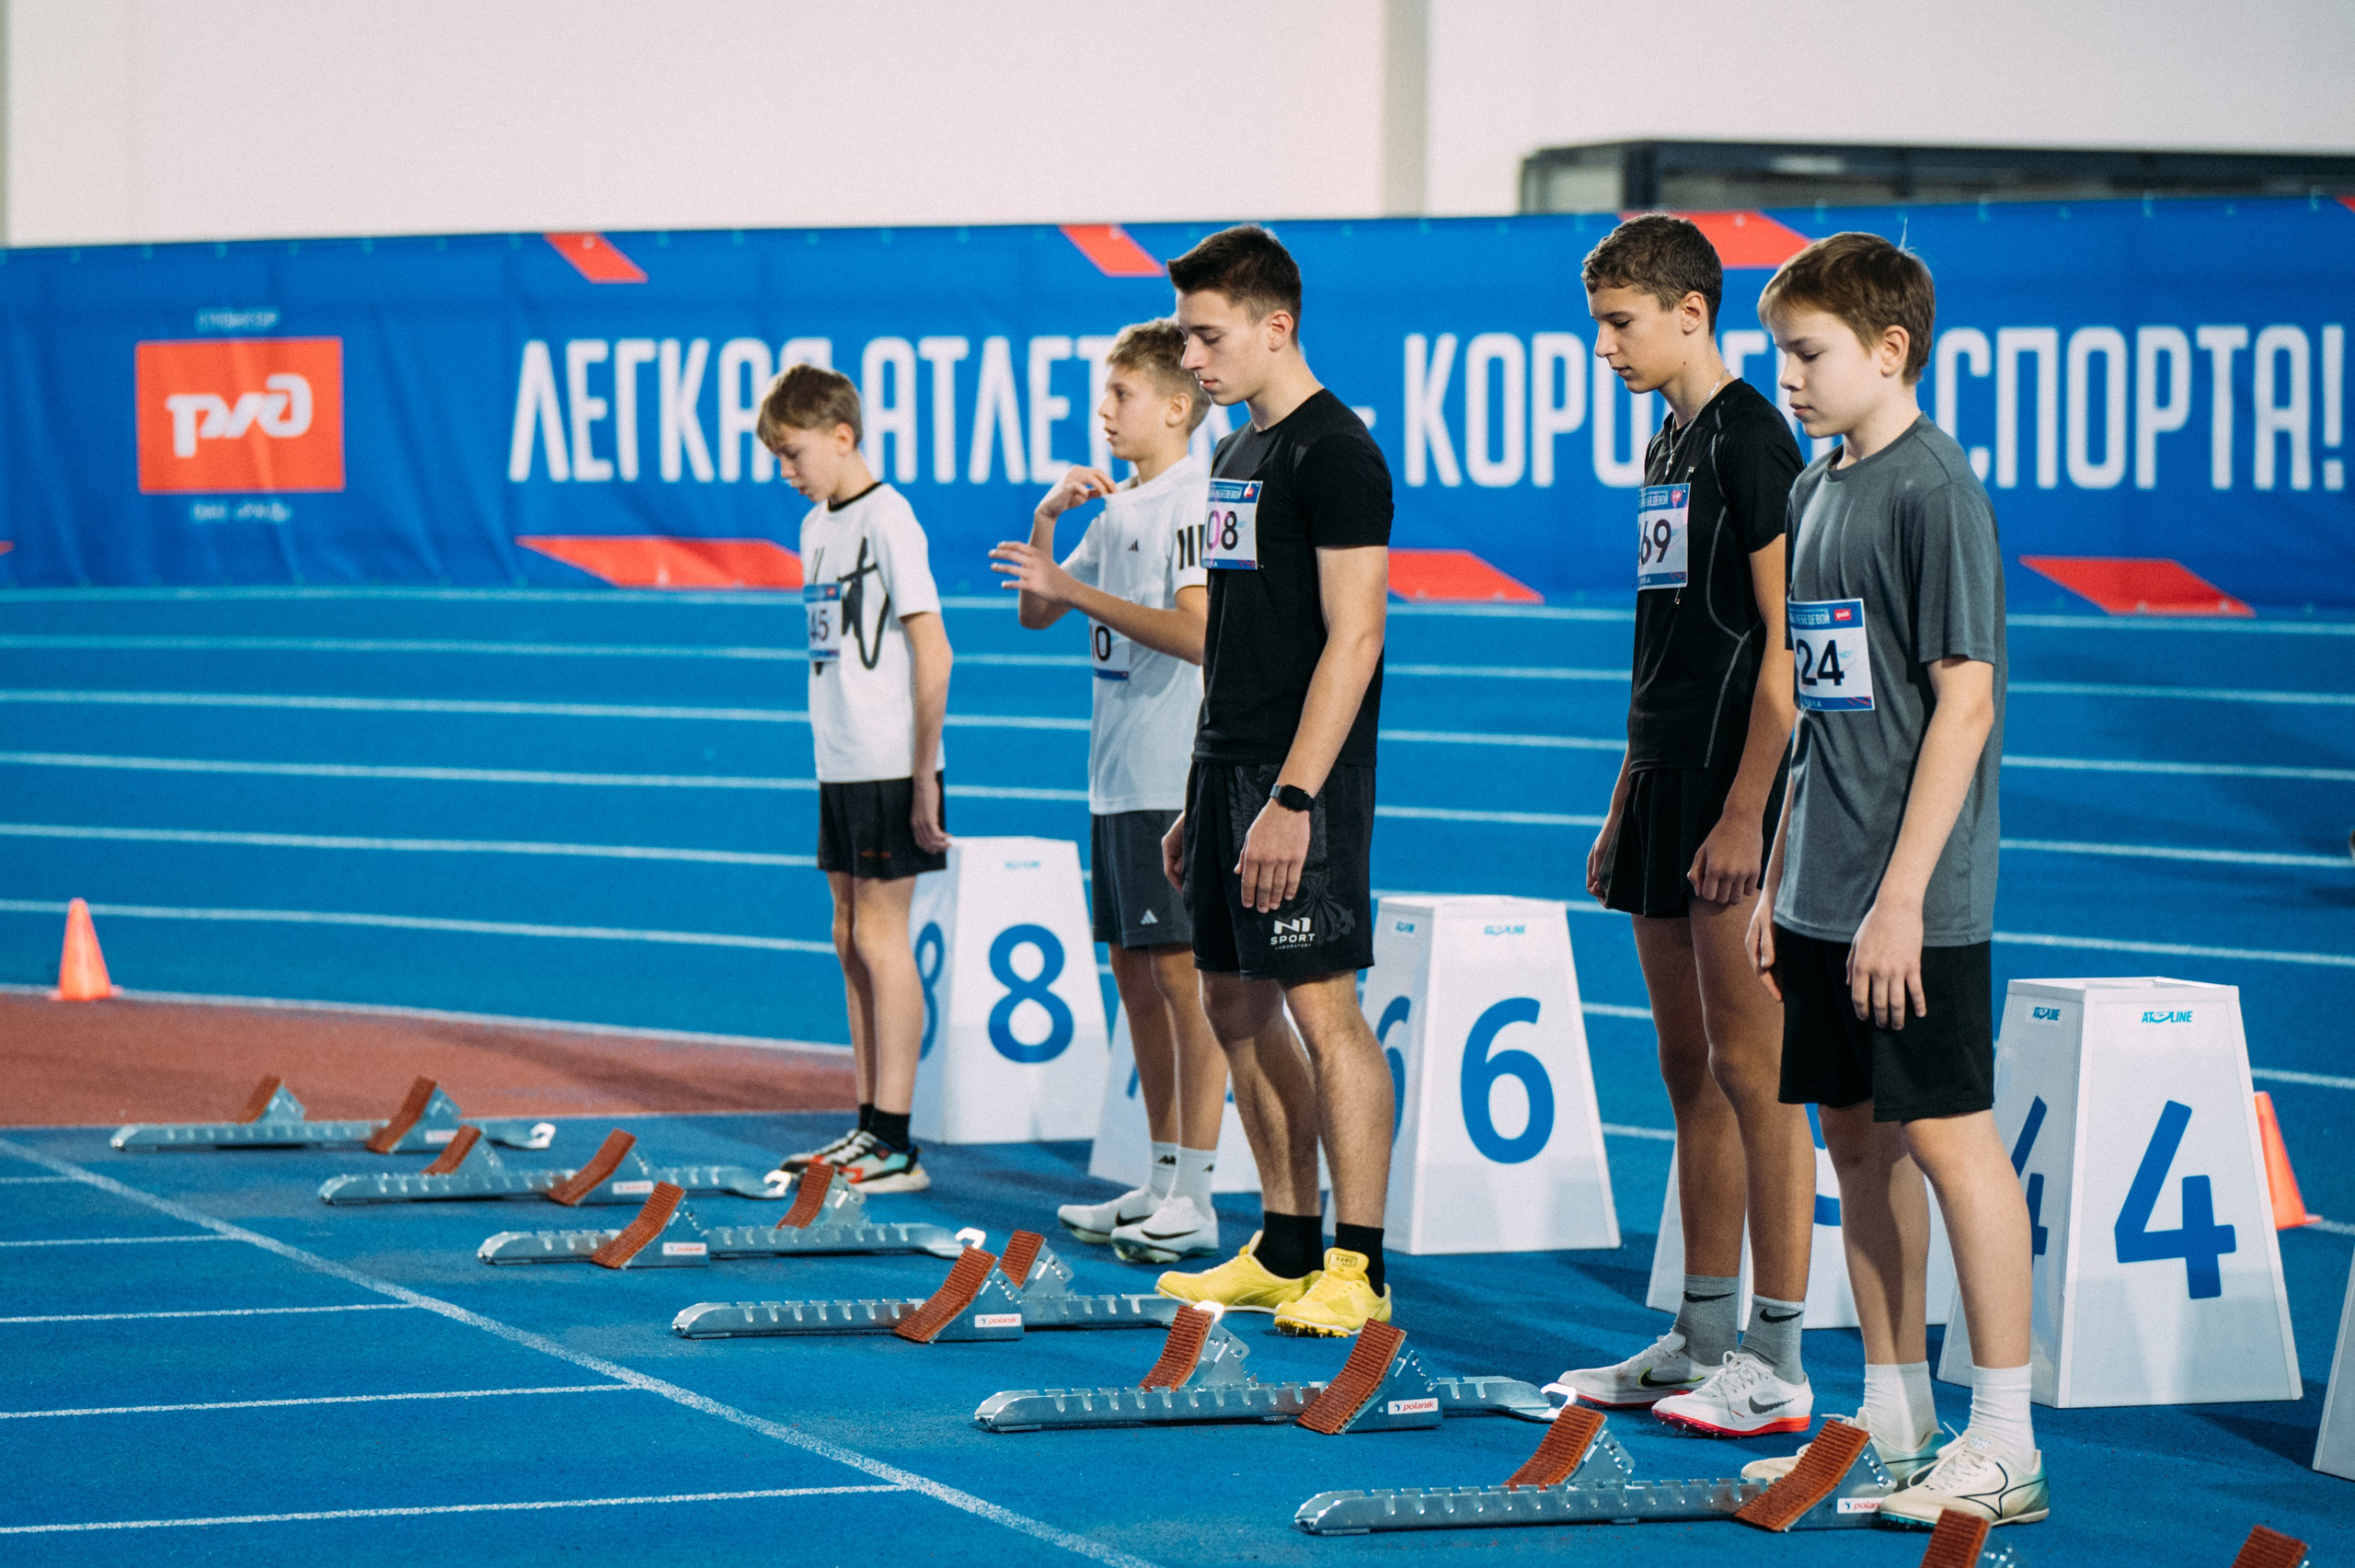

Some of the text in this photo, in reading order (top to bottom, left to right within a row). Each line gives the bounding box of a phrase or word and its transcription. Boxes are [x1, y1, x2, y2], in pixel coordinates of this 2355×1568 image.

[508, 337, 833, 484] ЛЕГКА
[1935, 325, 2345, 490] СПОРТА!
[988, 923, 1074, 1064] 8
[1270, 933, 1315, 944] SPORT
[1461, 997, 1555, 1164] 6
[2114, 1100, 2236, 1299] 4
[1403, 1401, 1434, 1411] polanik
[1854, 1501, 1882, 1511] polan
